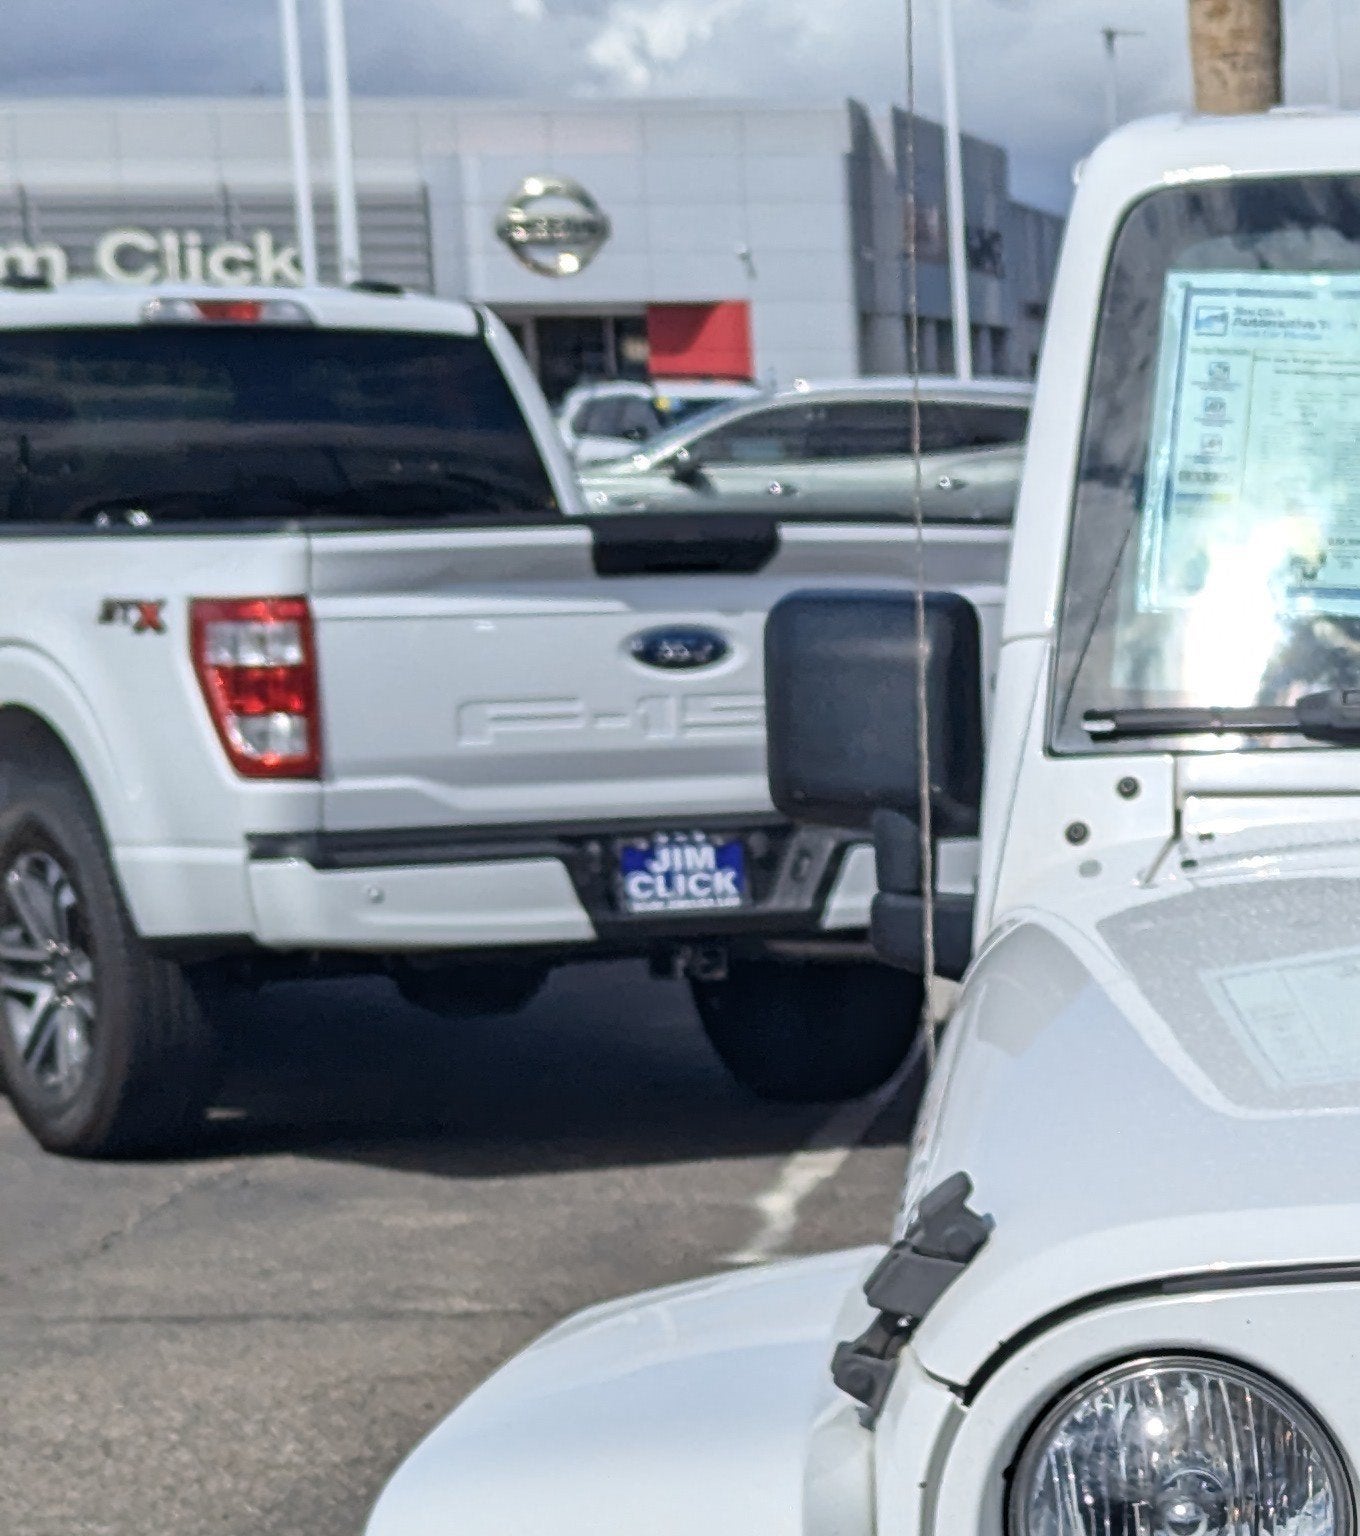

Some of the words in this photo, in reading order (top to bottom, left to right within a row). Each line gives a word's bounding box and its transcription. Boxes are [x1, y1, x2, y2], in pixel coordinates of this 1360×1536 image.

[97, 229, 303, 285] Click
[644, 846, 716, 873] JIM
[626, 868, 740, 900] CLICK
